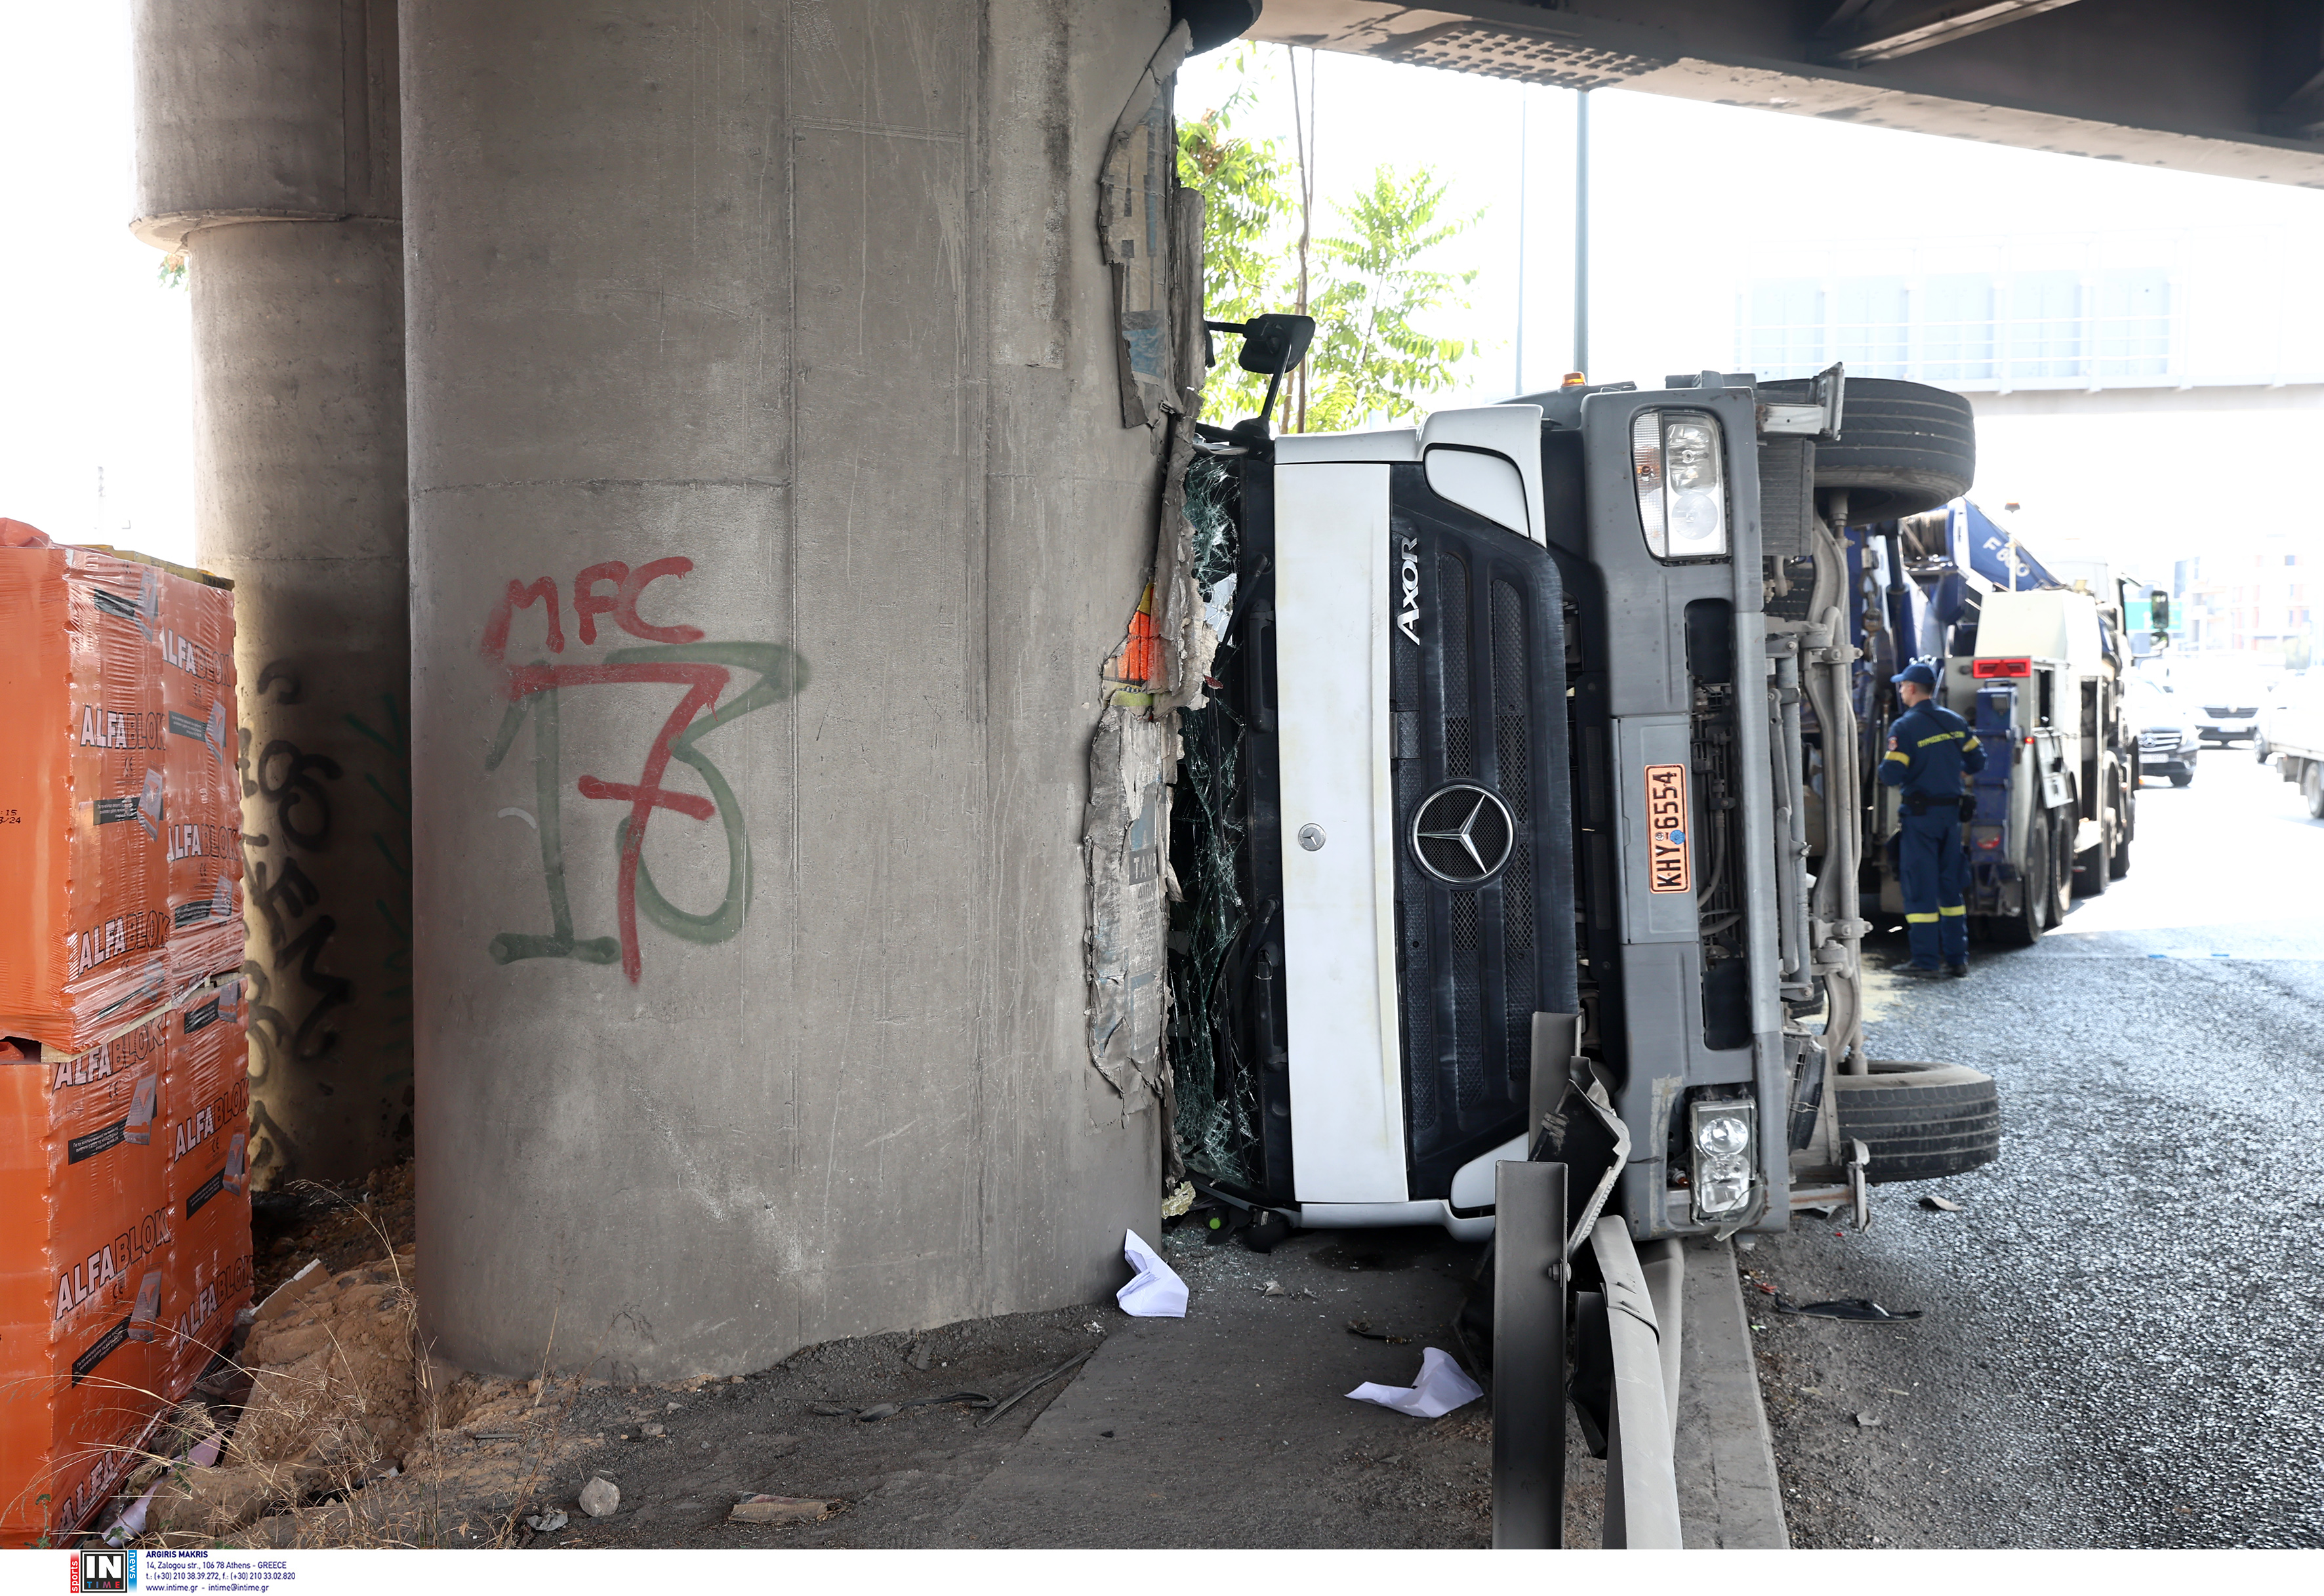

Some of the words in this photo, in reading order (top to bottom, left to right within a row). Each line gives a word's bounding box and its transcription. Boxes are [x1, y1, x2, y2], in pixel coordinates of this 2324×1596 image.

[1397, 537, 1419, 645] AXOR
[80, 705, 166, 750] ALFABLOK
[78, 911, 170, 978] ALFABLOK
[52, 1014, 166, 1094] ALFABLOK
[174, 1077, 249, 1165] ALFABLOK
[54, 1206, 171, 1322] ALFABLOK
[178, 1254, 254, 1355] ALFABLOK
